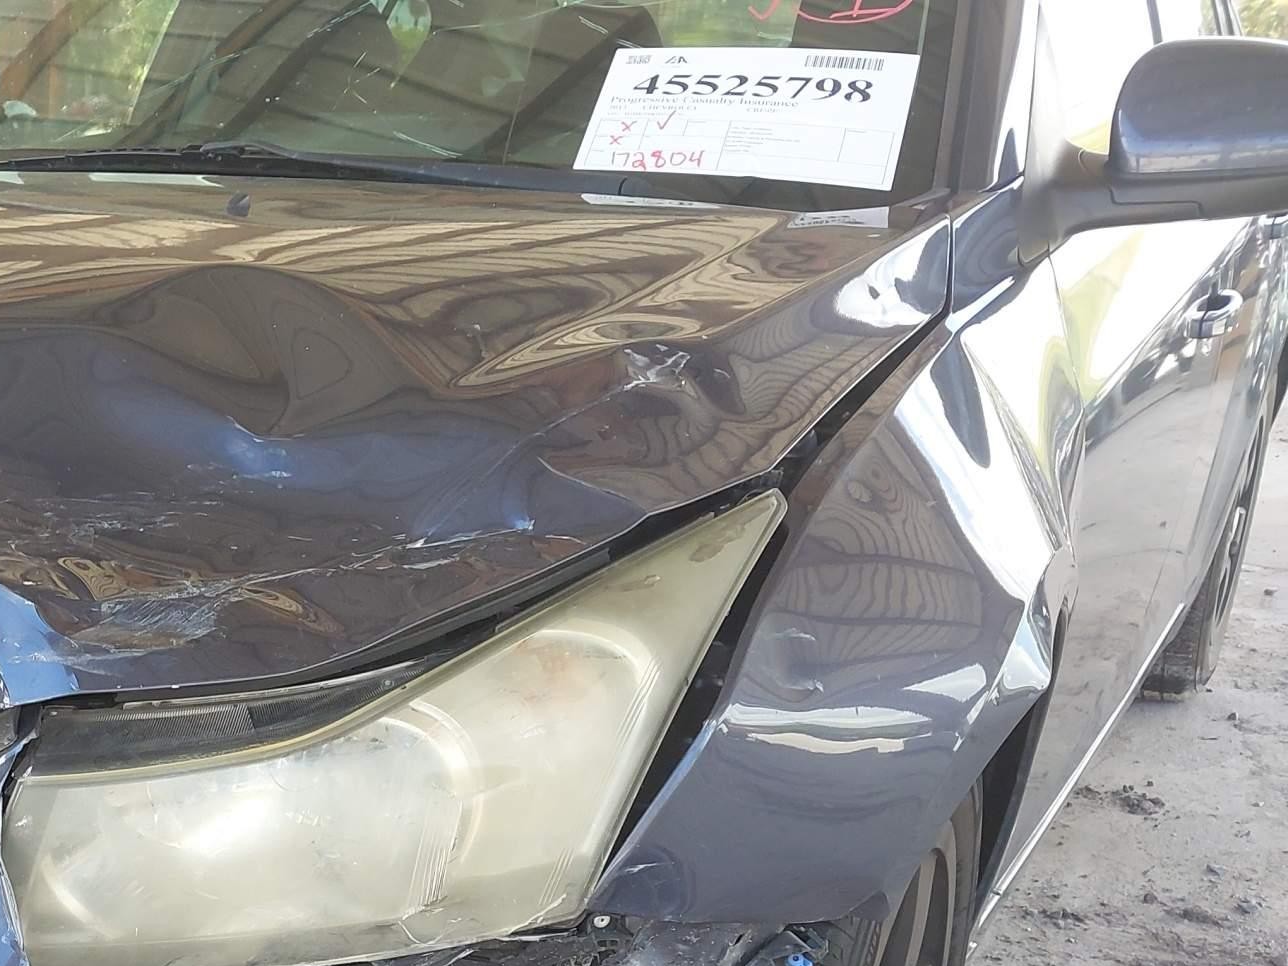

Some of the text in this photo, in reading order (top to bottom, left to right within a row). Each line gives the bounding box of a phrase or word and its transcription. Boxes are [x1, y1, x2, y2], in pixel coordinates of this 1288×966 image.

[633, 73, 873, 103] 45525798
[611, 95, 800, 108] Progressive Casualty Insurance
[611, 150, 706, 171] 172804
